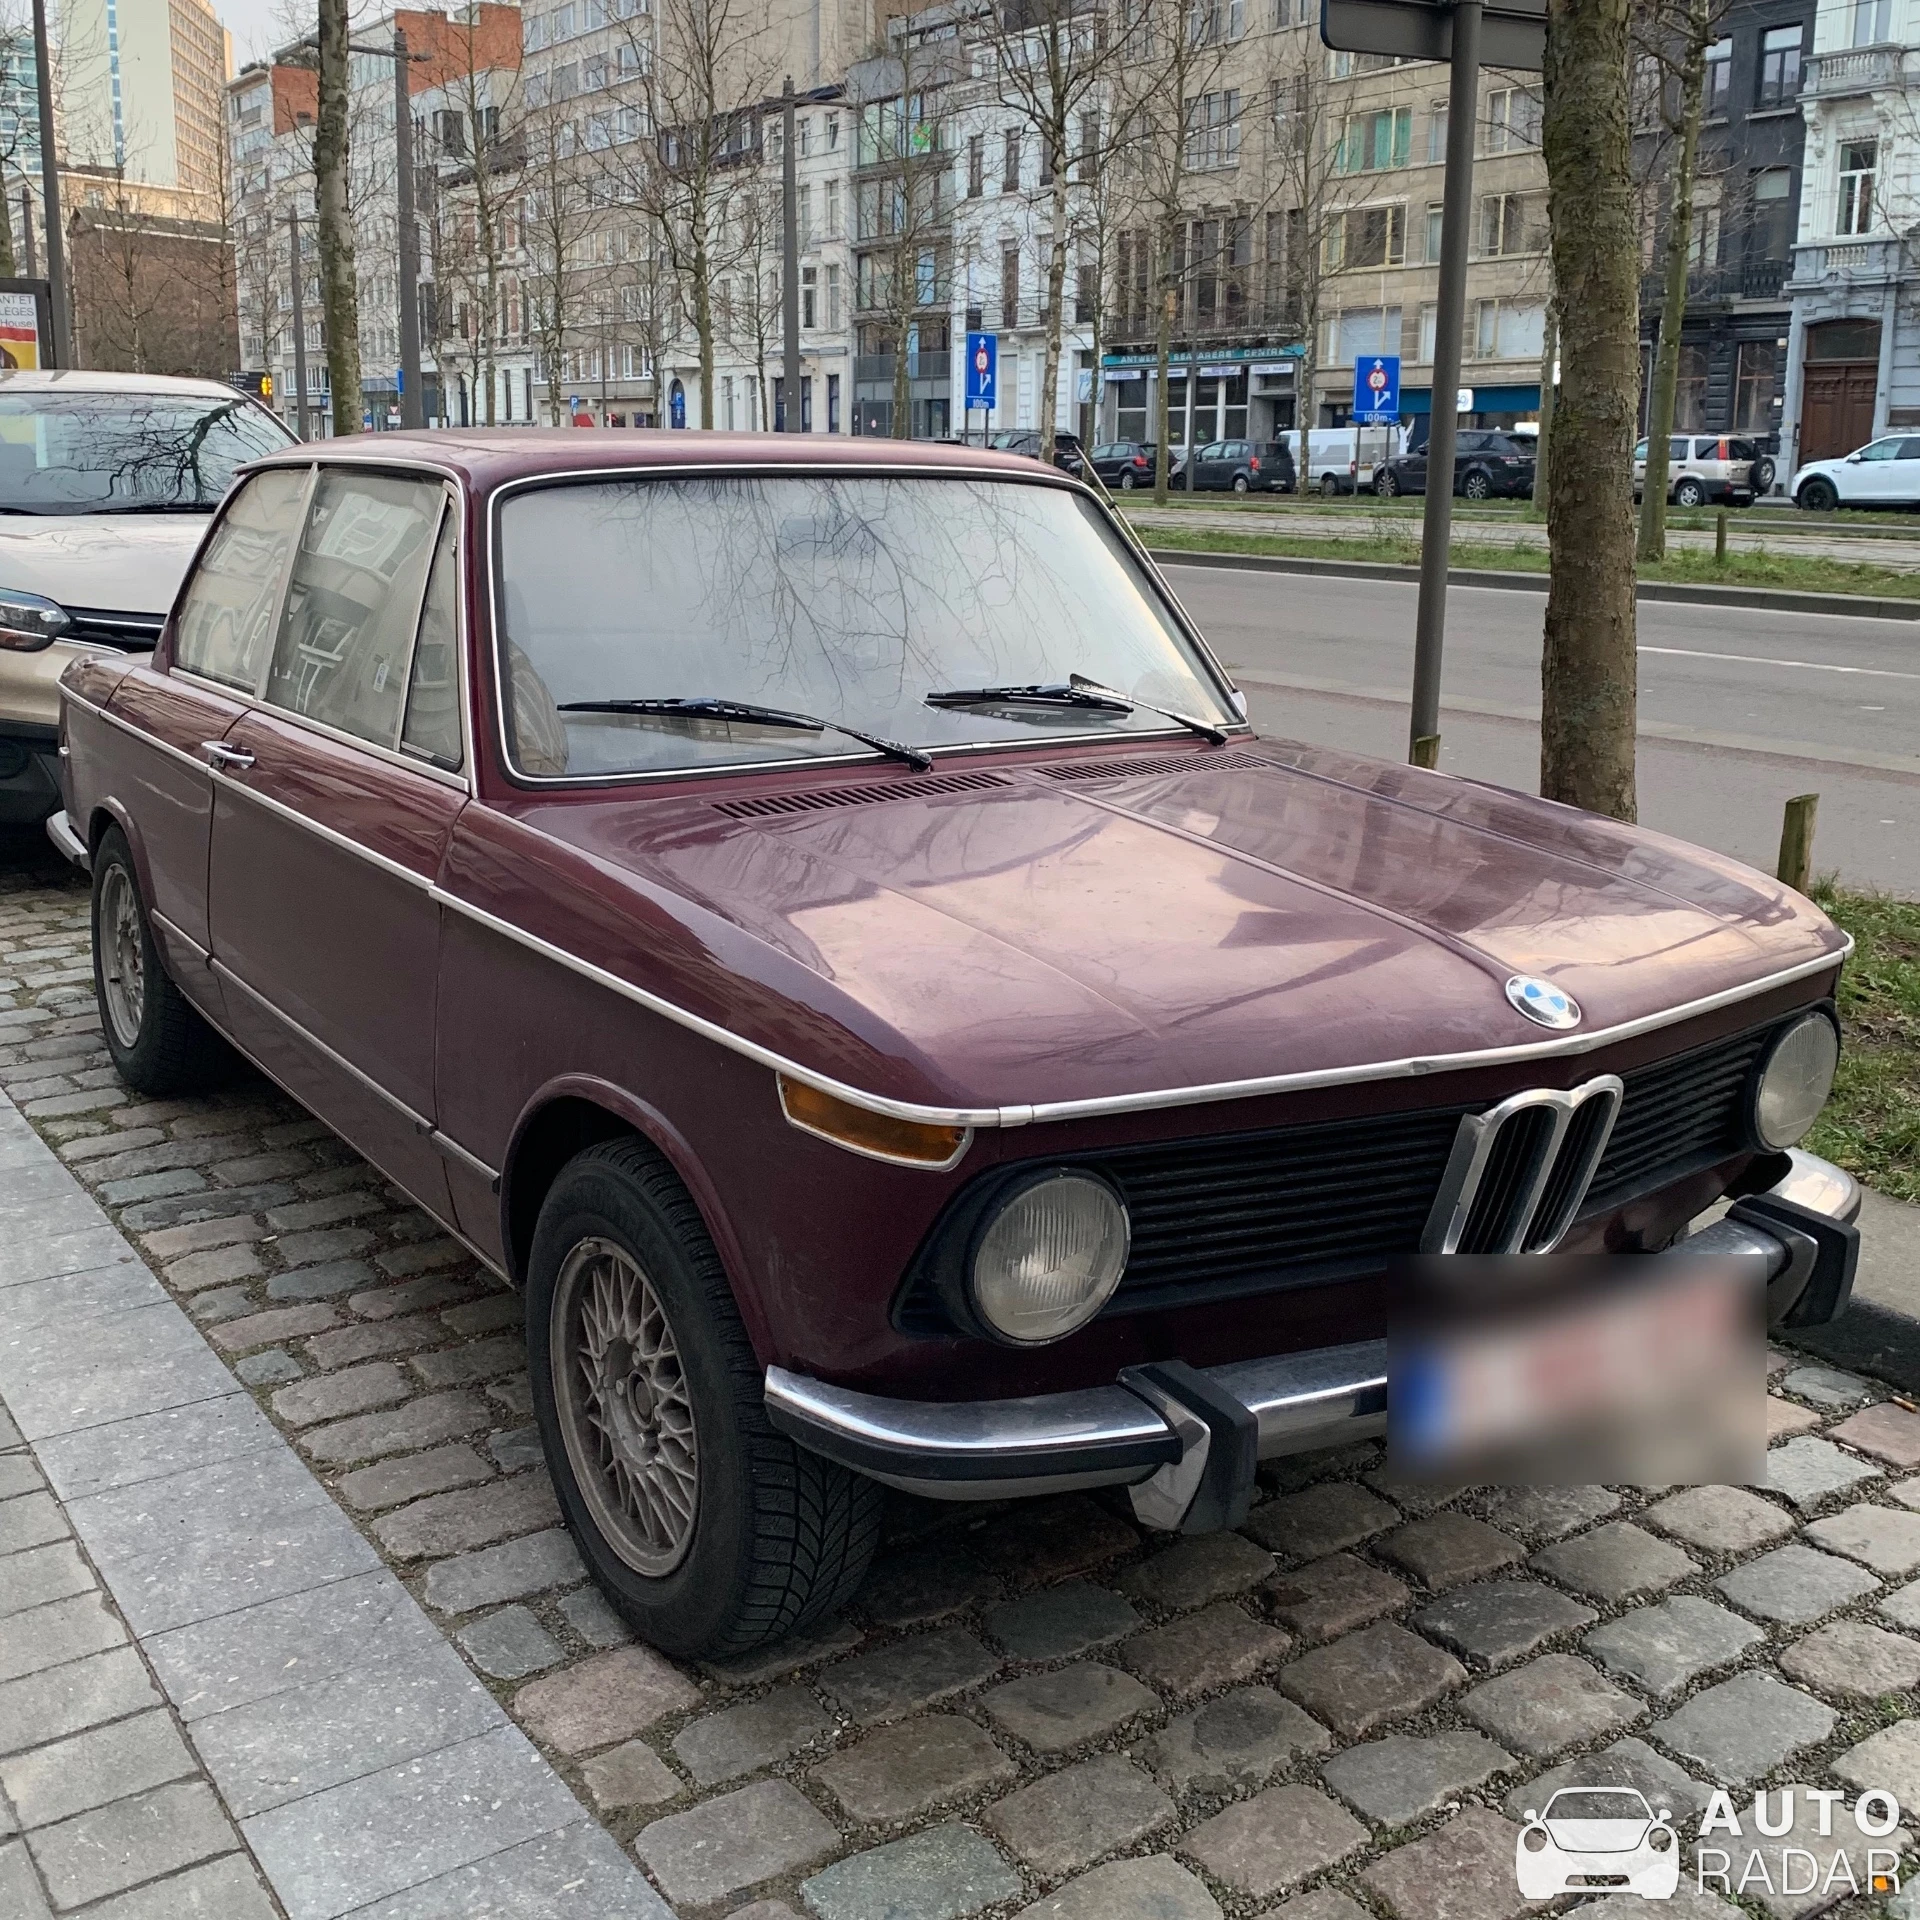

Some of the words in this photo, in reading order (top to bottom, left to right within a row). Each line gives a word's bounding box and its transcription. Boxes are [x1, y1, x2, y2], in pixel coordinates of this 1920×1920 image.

[19, 295, 33, 304] ET
[1120, 355, 1158, 364] ANTWER
[1173, 350, 1235, 361] SEAARERS'
